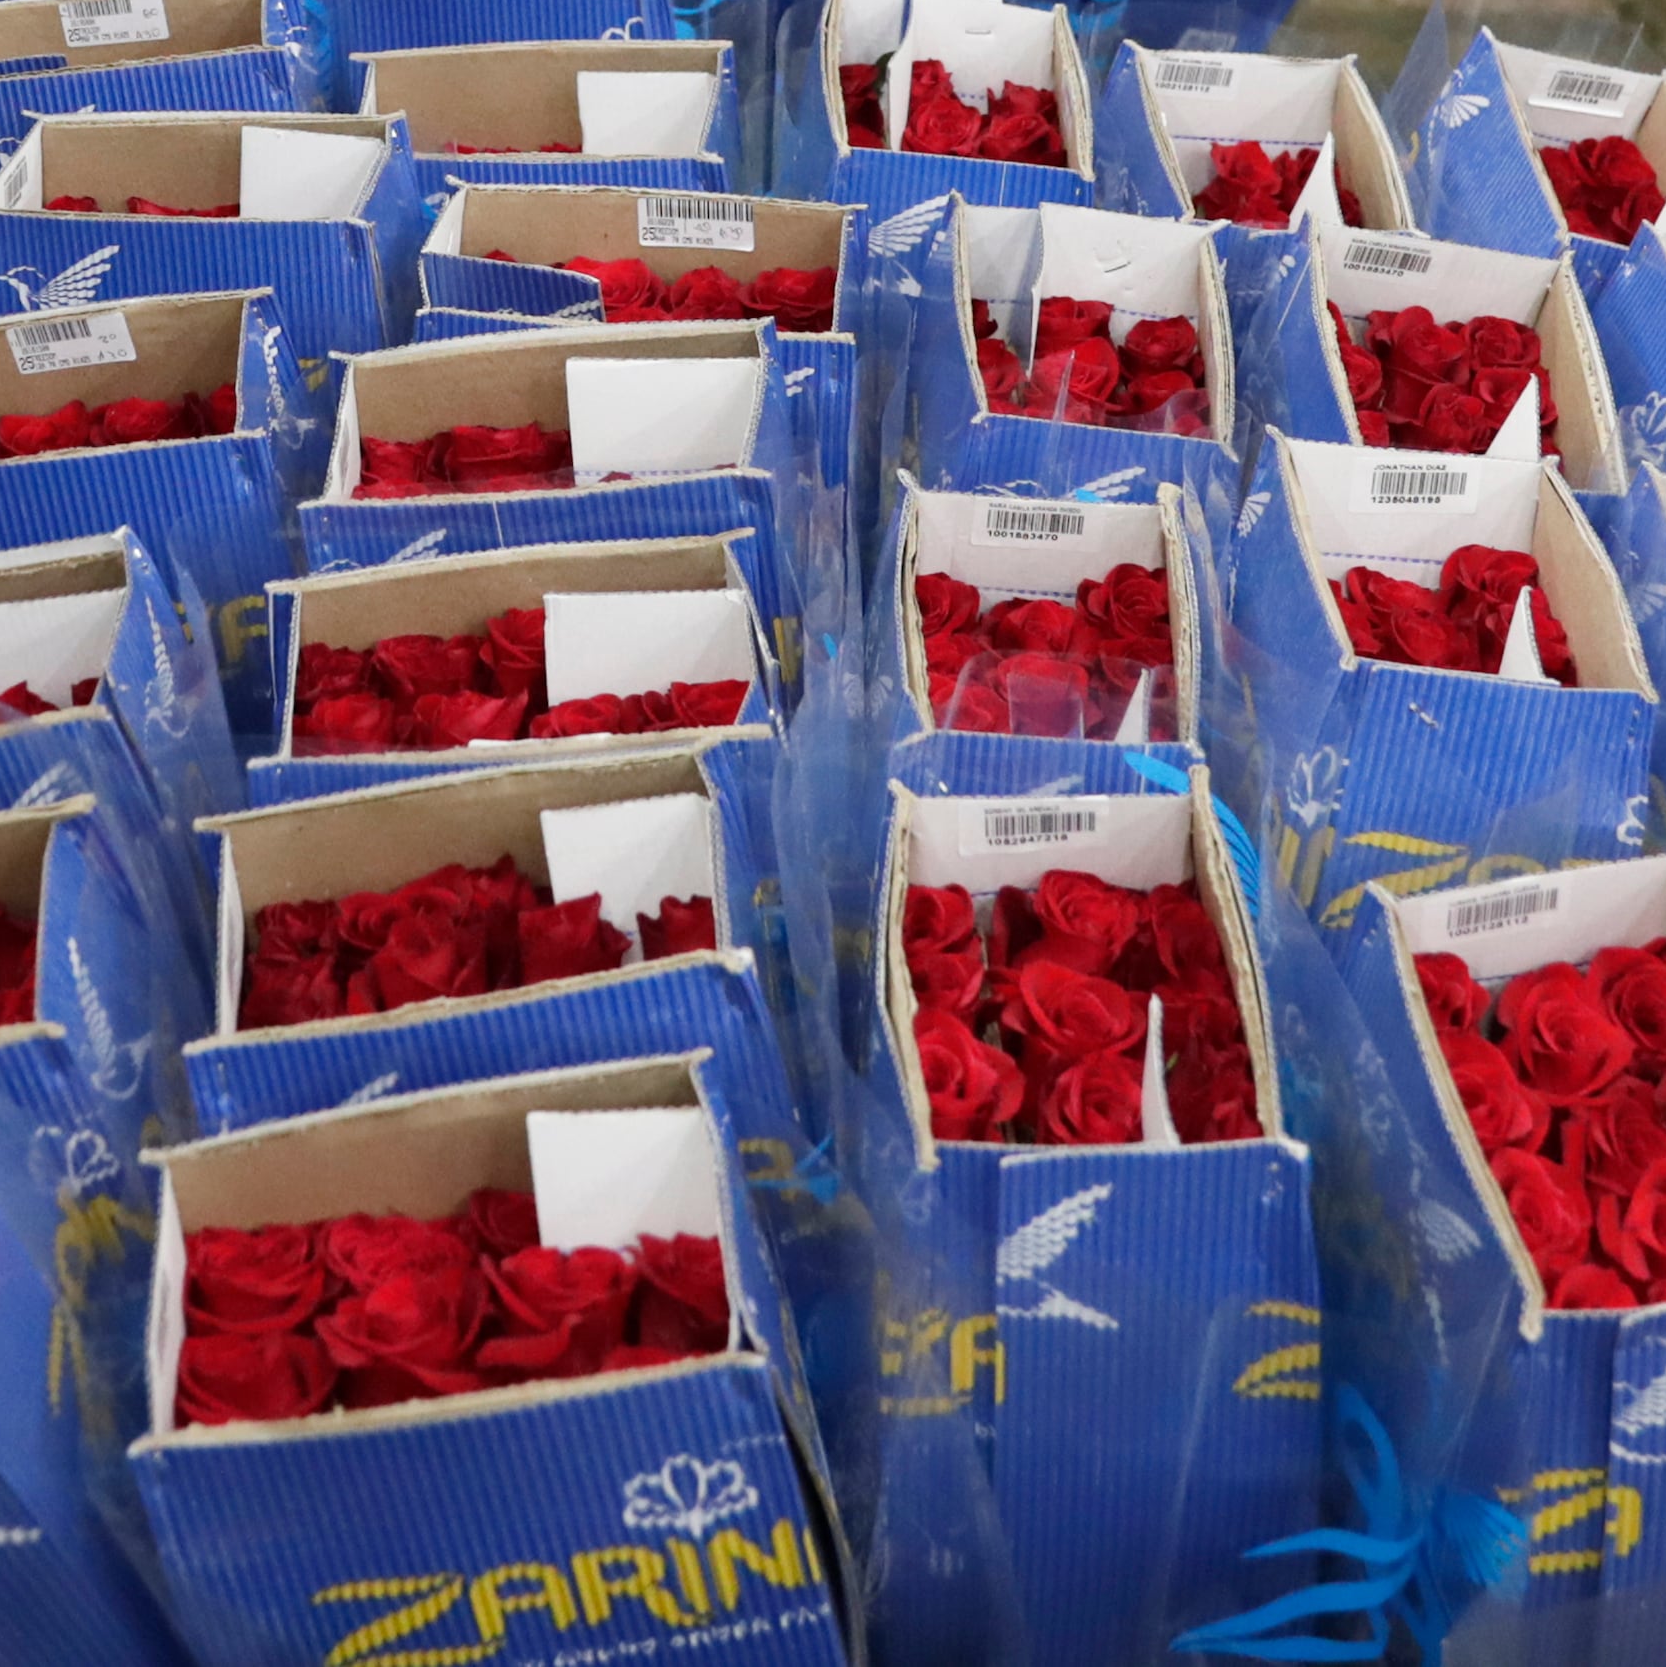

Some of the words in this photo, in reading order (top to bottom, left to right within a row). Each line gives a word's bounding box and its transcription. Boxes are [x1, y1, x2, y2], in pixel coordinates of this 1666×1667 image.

[67, 28, 81, 42] 25
[642, 227, 656, 241] 25
[19, 355, 35, 371] 25
[311, 1517, 824, 1667] ZARIN
